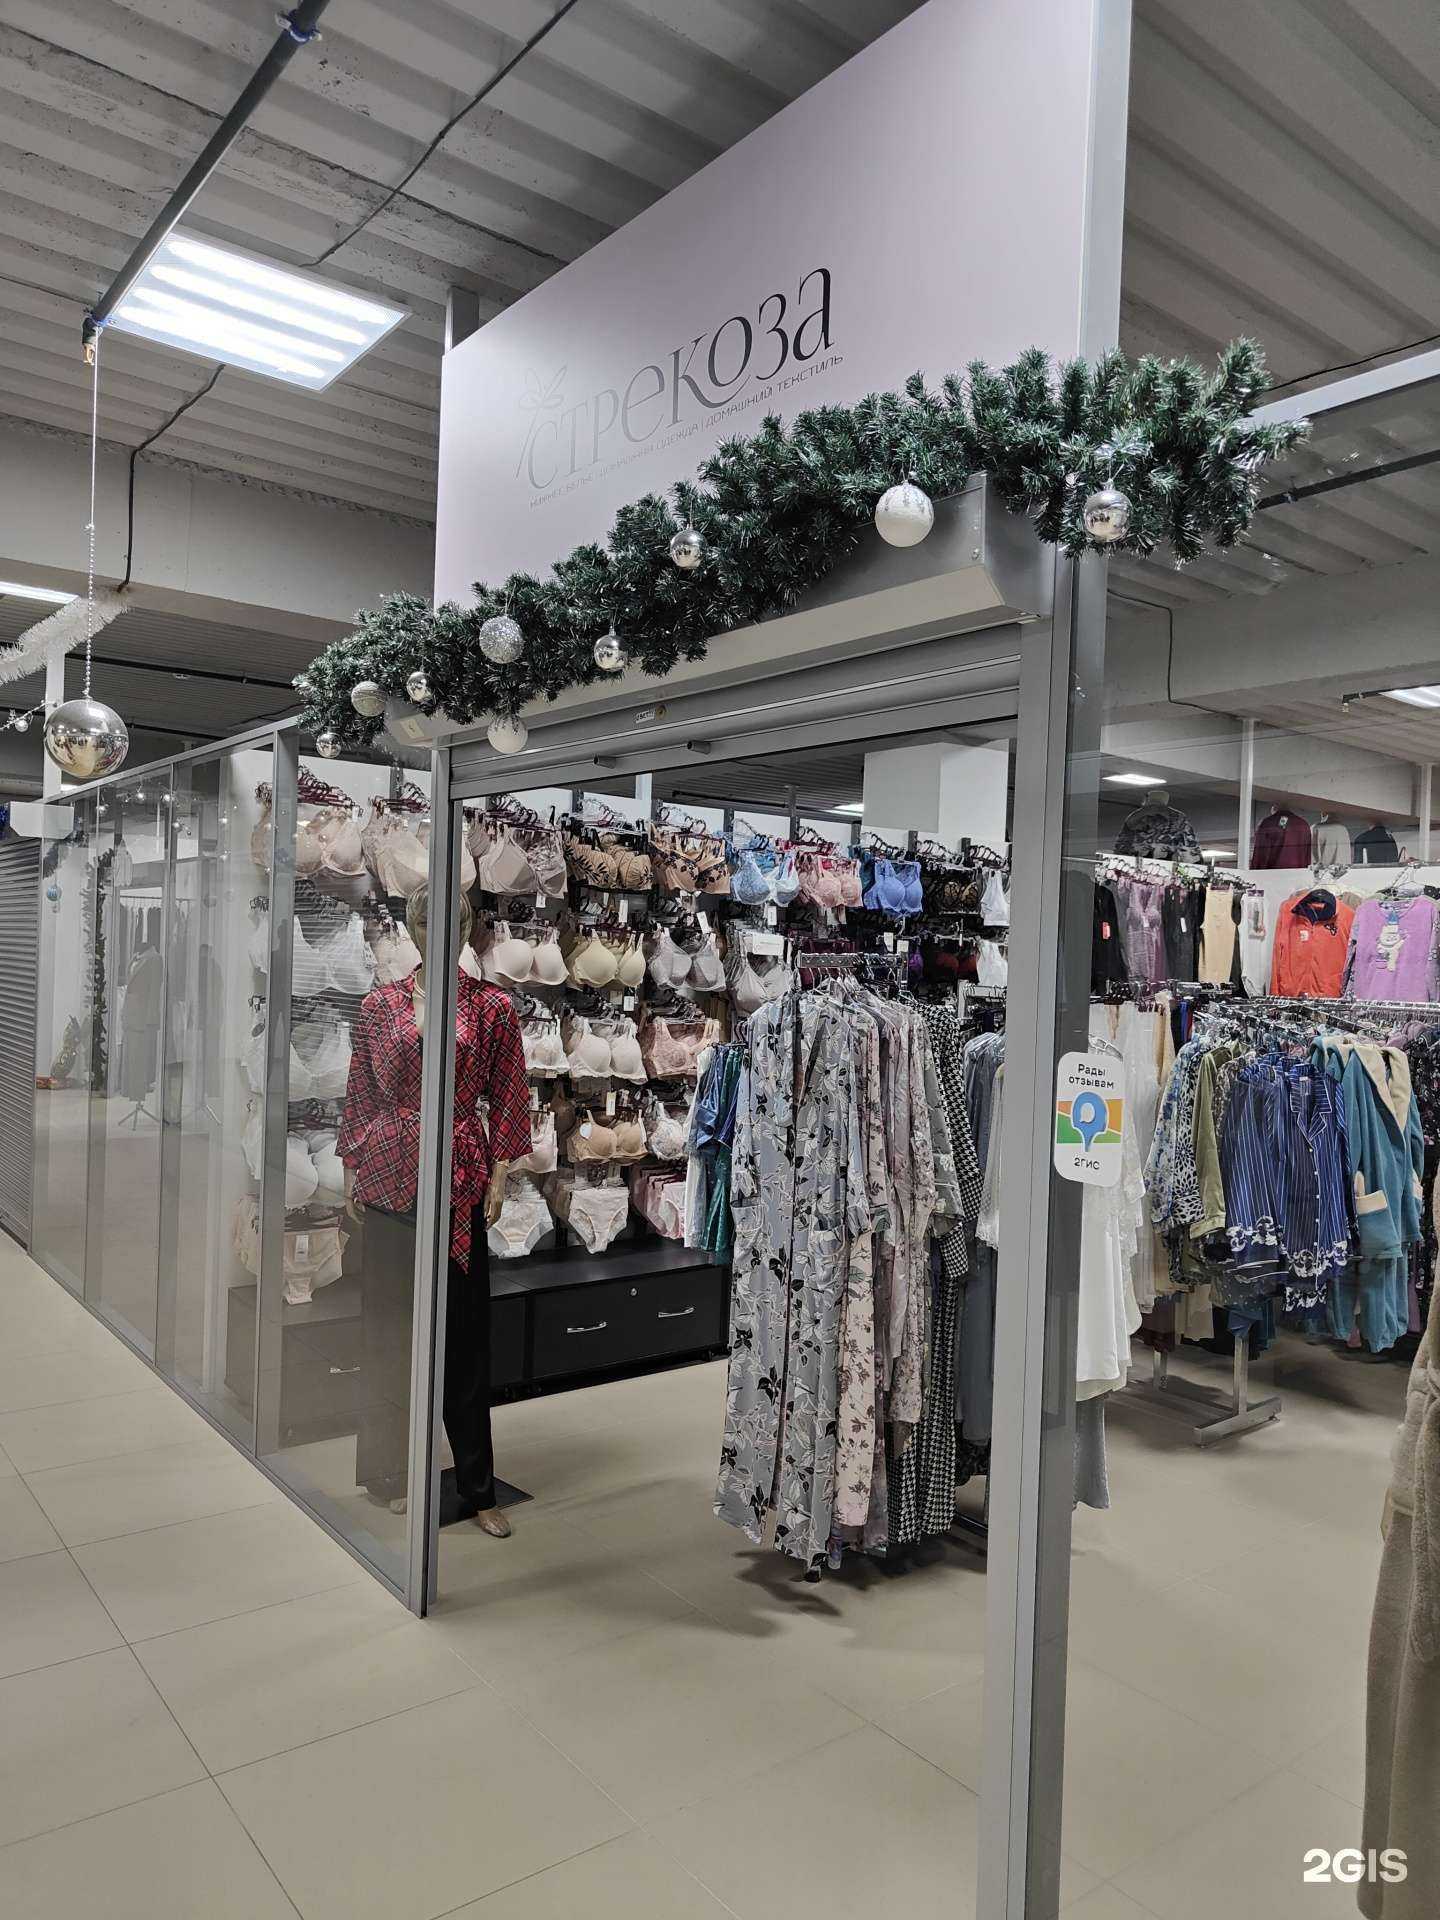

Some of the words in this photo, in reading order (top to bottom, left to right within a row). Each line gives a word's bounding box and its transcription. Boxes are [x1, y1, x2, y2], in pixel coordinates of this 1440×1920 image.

[705, 385, 774, 428] ДОМАШНИЙ
[776, 354, 844, 392] ТЕКСТИЛЬ
[1078, 1064, 1105, 1076] Рады
[1069, 1076, 1114, 1088] отзывам
[1074, 1157, 1101, 1170] 2ГИС
